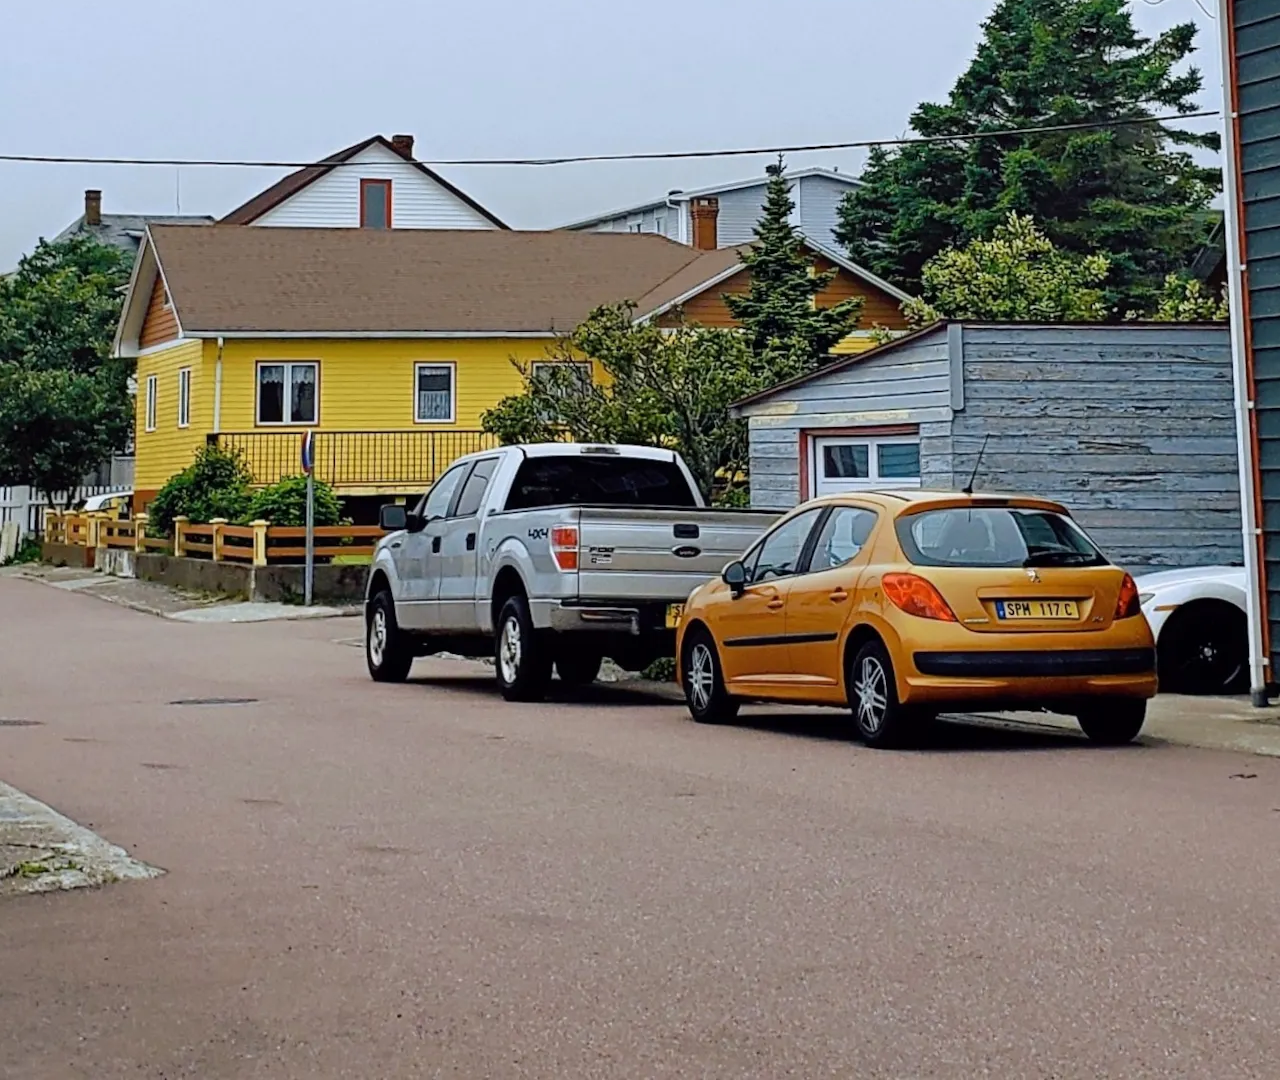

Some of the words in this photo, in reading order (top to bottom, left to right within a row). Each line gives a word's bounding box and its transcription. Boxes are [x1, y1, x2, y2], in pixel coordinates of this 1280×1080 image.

[1007, 603, 1032, 616] SPM
[1040, 603, 1060, 616] 117
[1064, 603, 1073, 616] C
